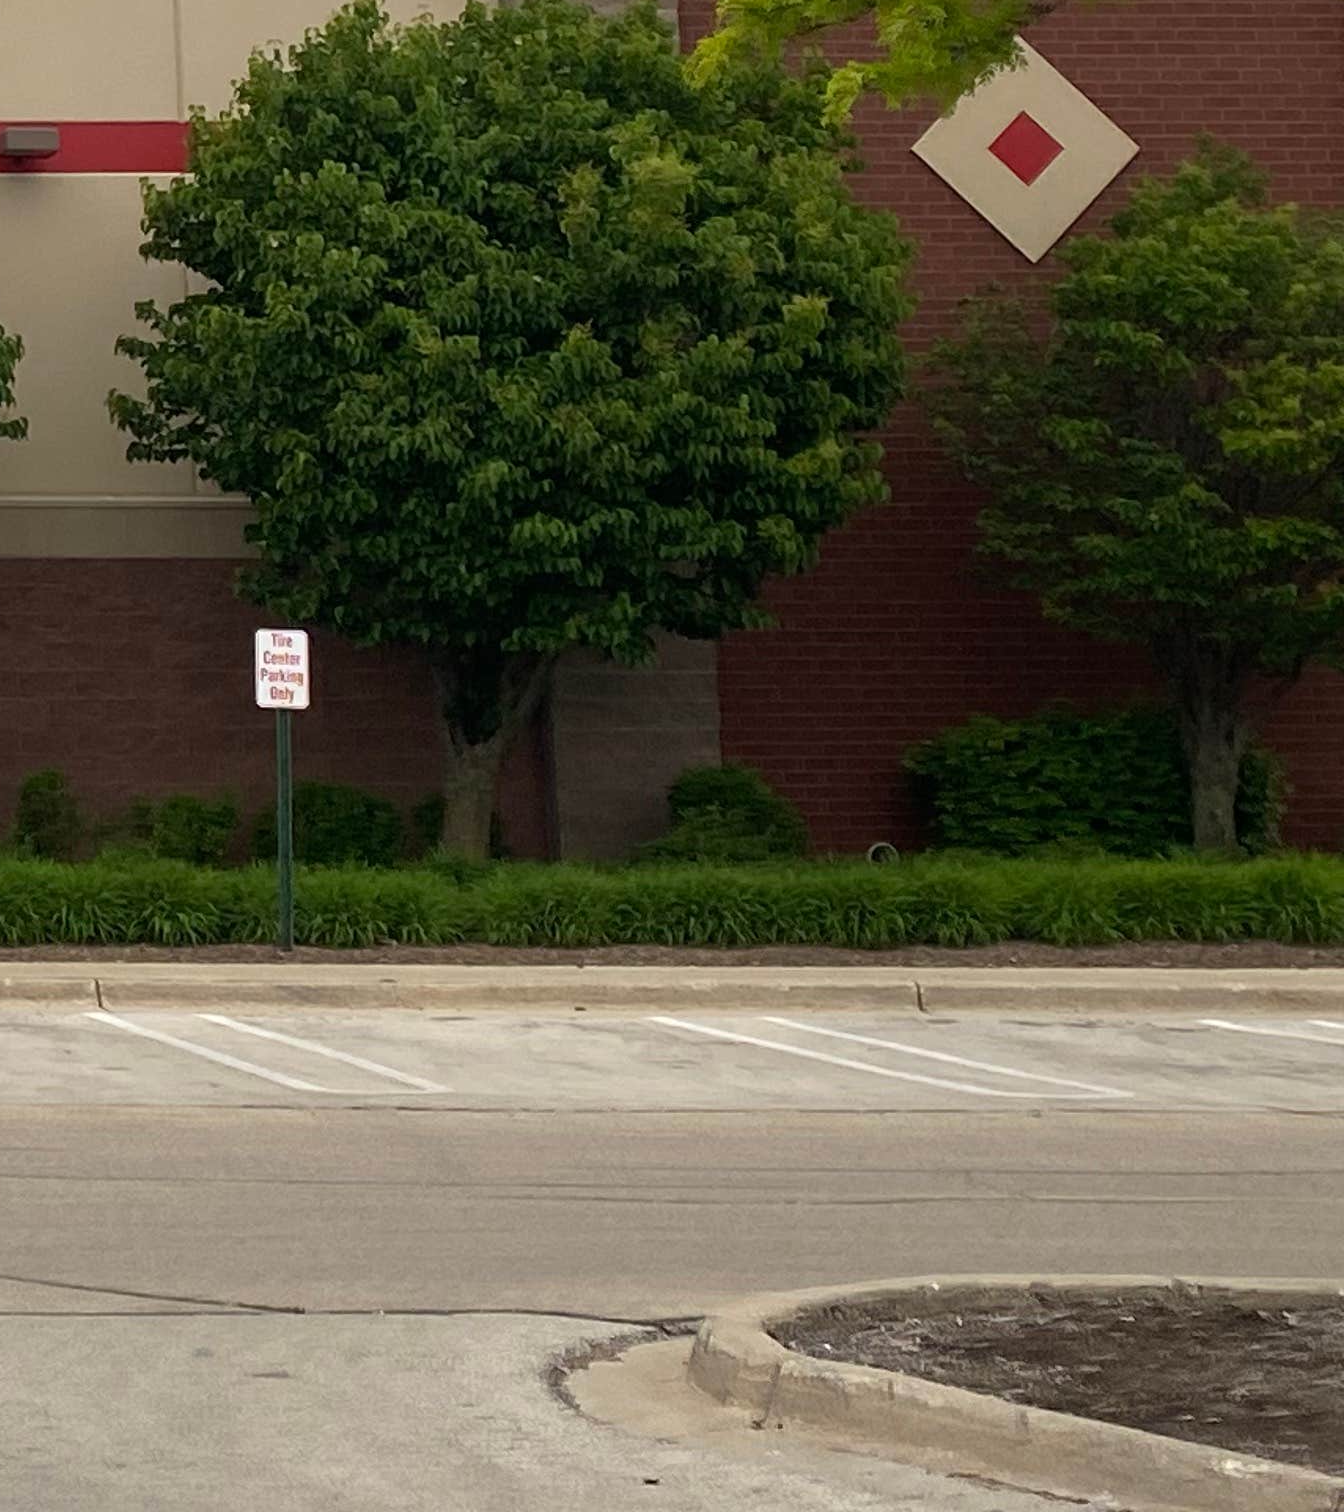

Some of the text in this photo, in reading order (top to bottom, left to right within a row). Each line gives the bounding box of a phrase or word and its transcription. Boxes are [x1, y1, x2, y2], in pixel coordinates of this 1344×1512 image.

[271, 633, 293, 648] Tire
[263, 650, 301, 665] Center
[260, 668, 304, 686] Parking
[270, 686, 295, 704] Only
